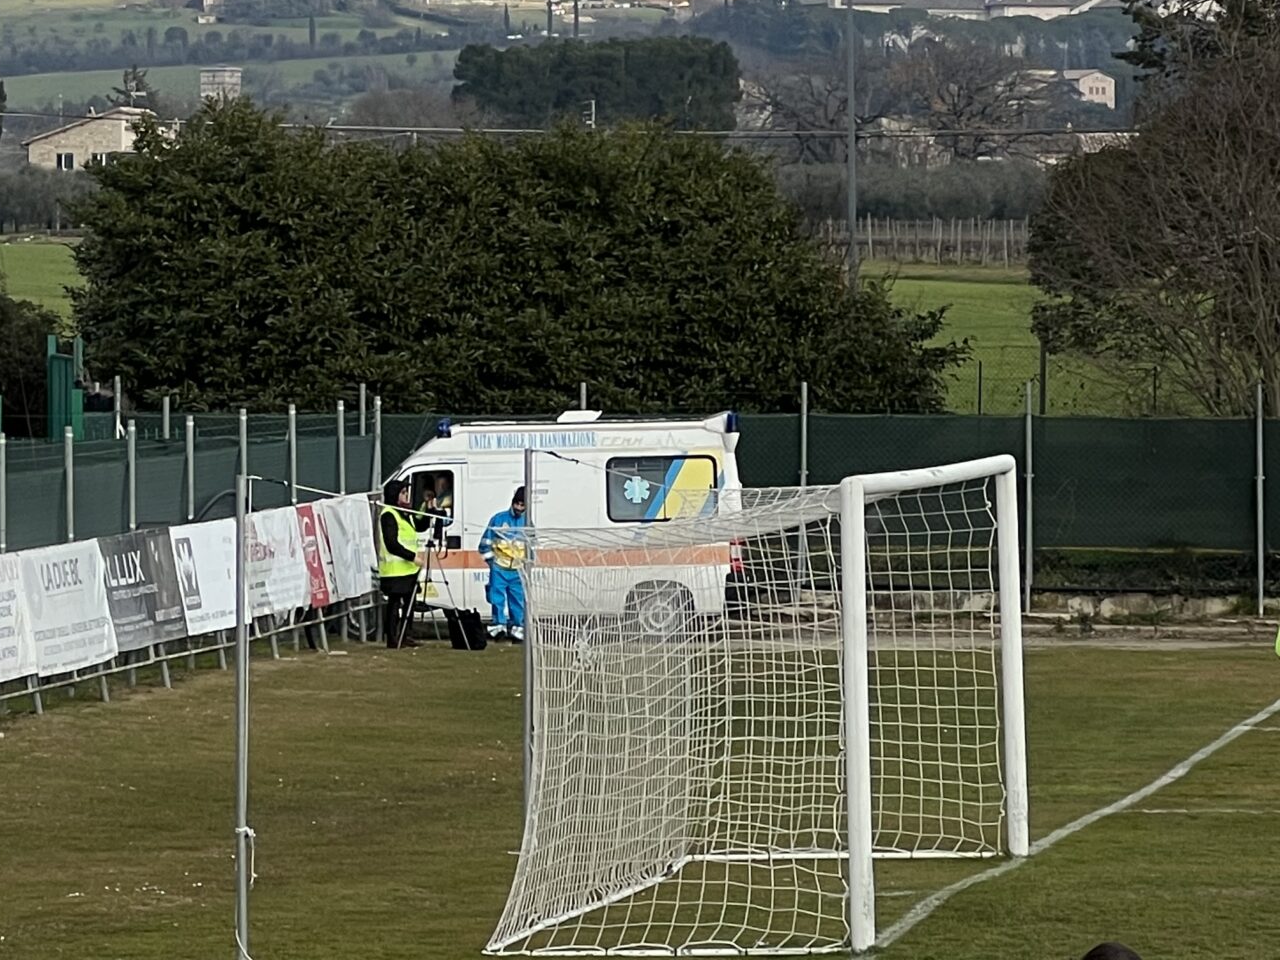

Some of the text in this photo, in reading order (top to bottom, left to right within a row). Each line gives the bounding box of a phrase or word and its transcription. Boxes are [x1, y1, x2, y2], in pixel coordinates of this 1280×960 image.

[497, 432, 526, 449] MOBILE
[528, 431, 537, 448] DI
[539, 430, 597, 448] RIANIMAZIONE
